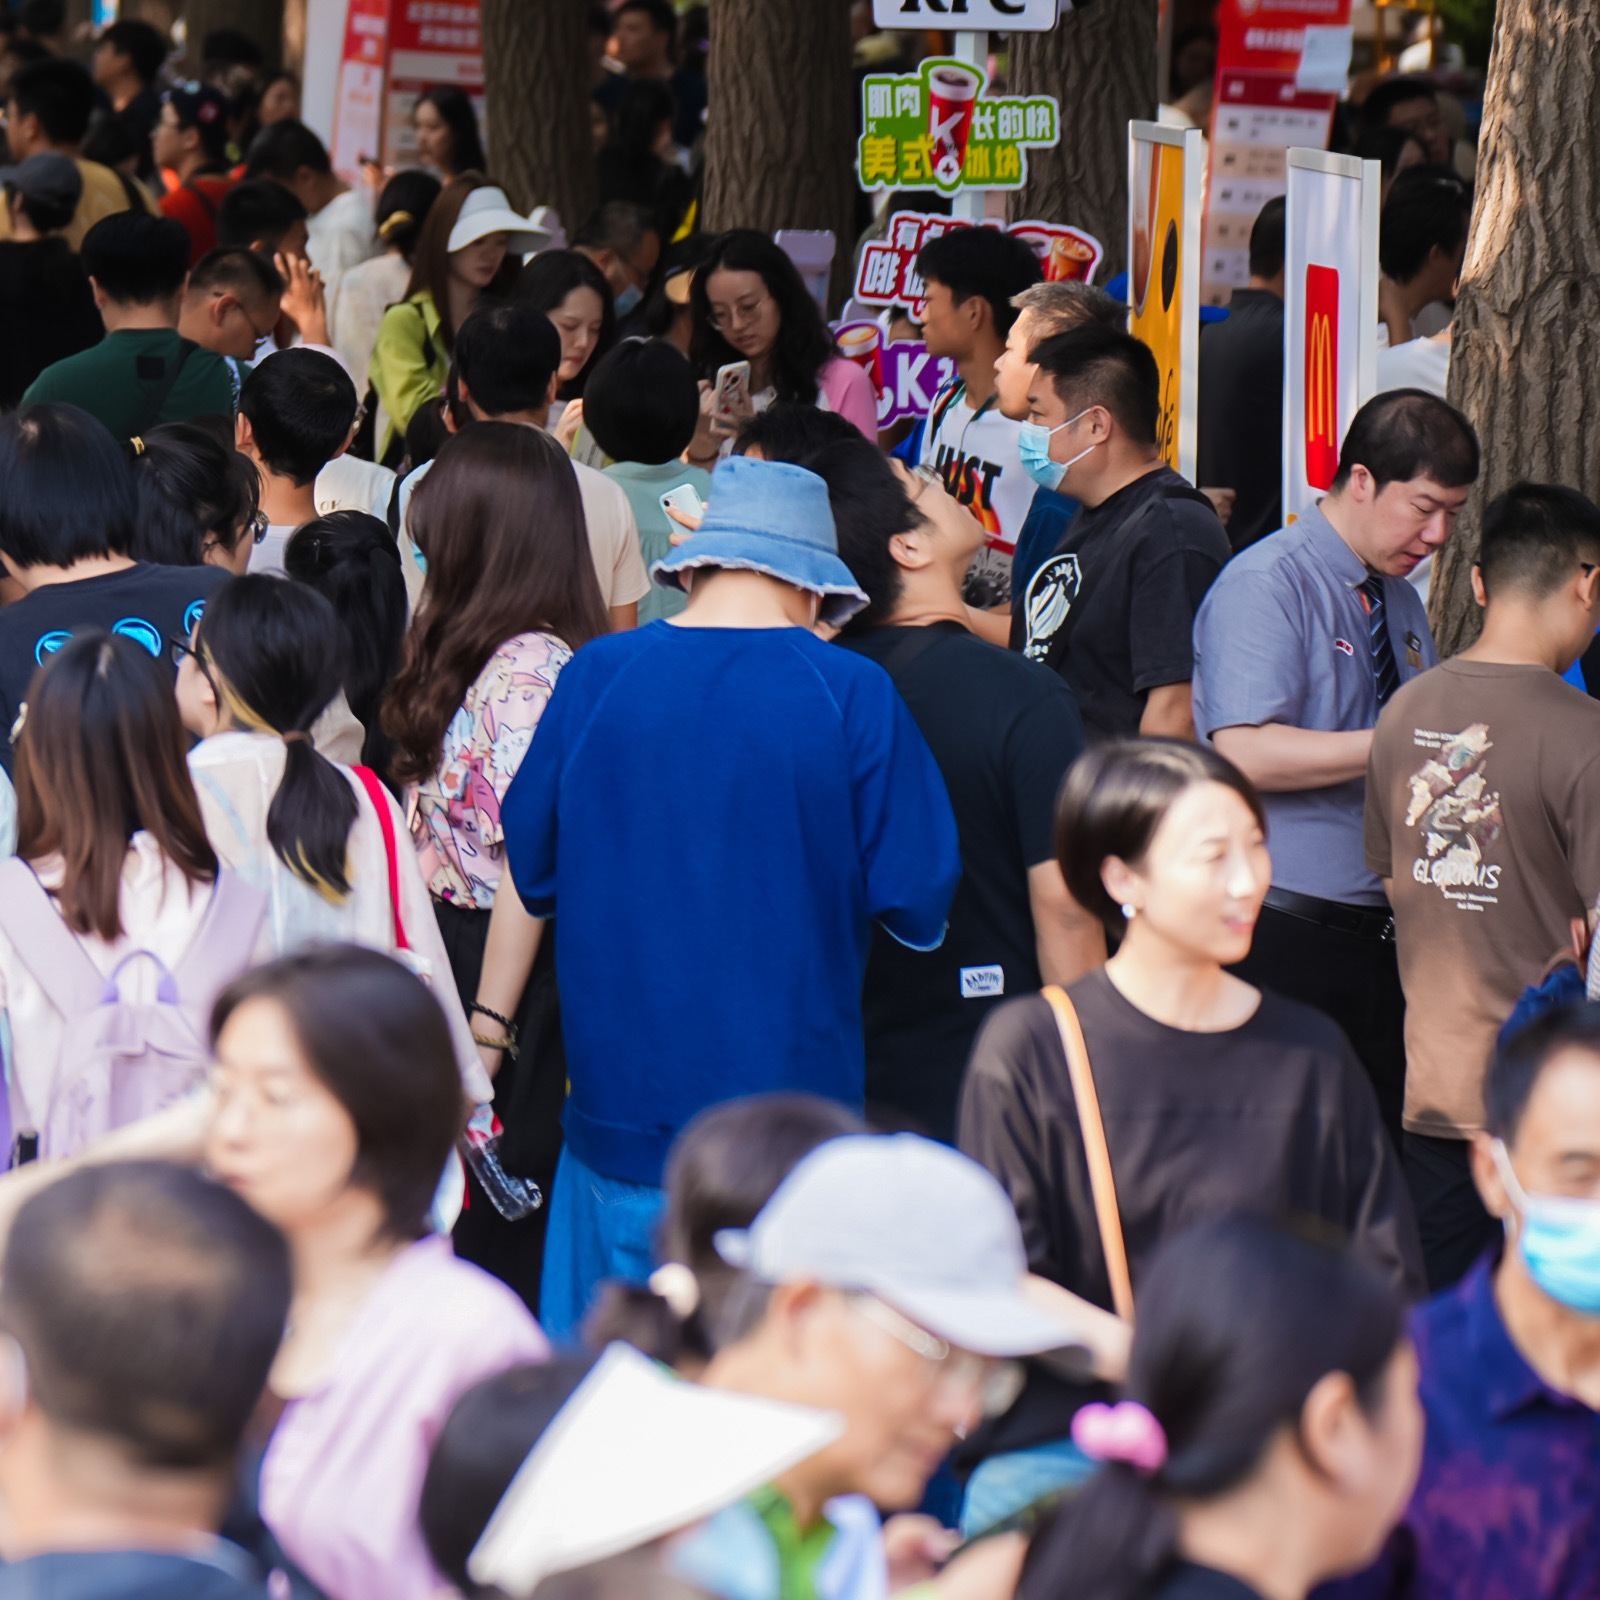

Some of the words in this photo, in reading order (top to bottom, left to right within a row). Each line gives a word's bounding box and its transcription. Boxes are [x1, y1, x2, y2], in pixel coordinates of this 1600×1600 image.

[868, 84, 921, 118] 肌肉
[972, 105, 1050, 140] 长的快
[864, 134, 935, 180] 美式
[965, 144, 1020, 179] 冰块
[1413, 857, 1502, 890] GLORIOUS
